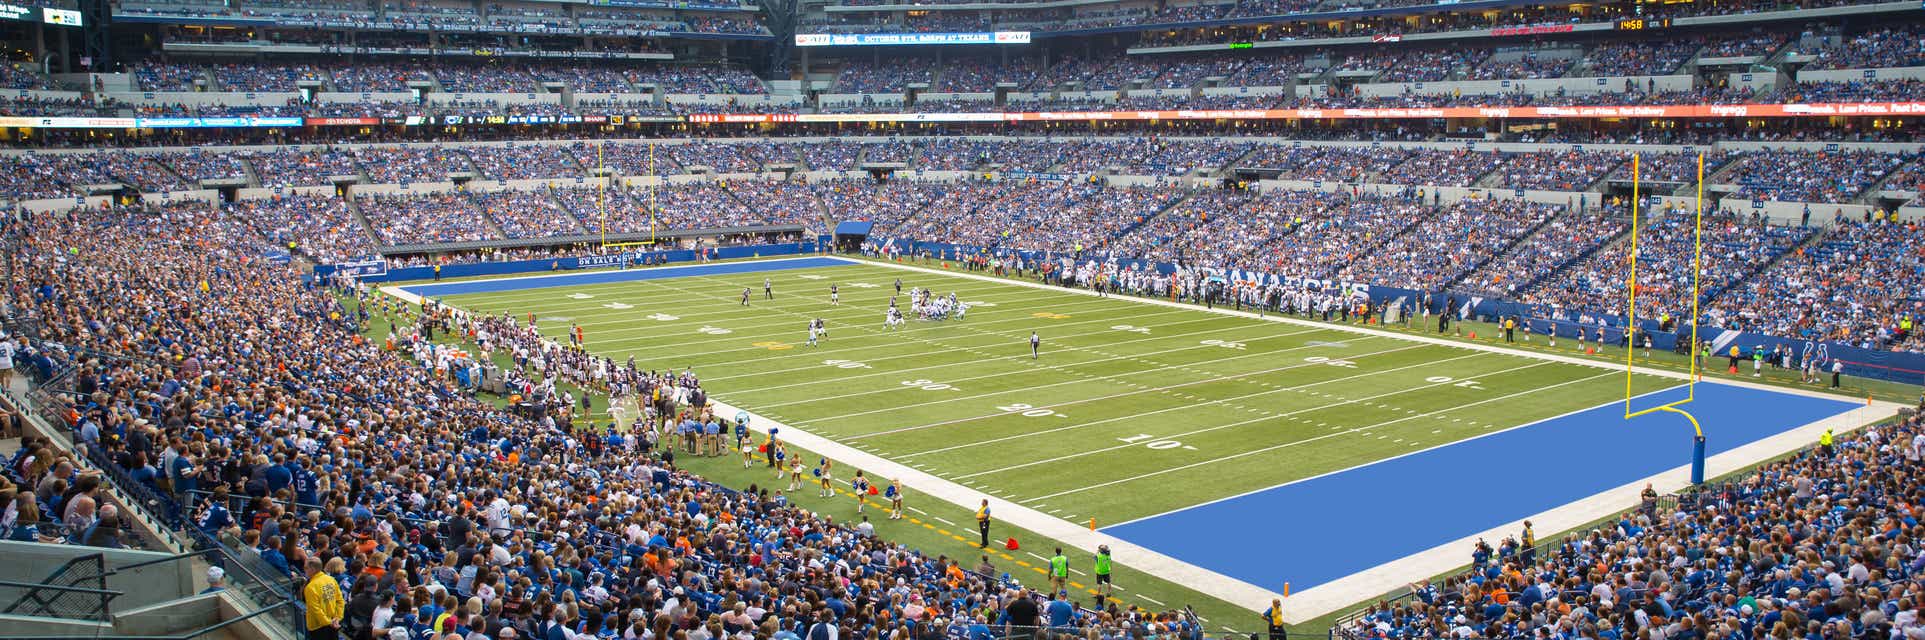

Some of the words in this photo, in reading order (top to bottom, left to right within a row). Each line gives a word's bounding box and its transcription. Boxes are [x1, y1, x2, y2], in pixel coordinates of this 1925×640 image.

[1620, 19, 1643, 30] 14:58
[1711, 105, 1747, 116] hhgregg
[1838, 105, 1857, 113] Low
[1890, 102, 1910, 111] Fast
[578, 257, 590, 265] ON
[592, 255, 614, 264] SALE
[902, 378, 951, 391] 30
[997, 403, 1056, 418] 20
[1117, 433, 1182, 450] 10
[297, 479, 307, 492] 12
